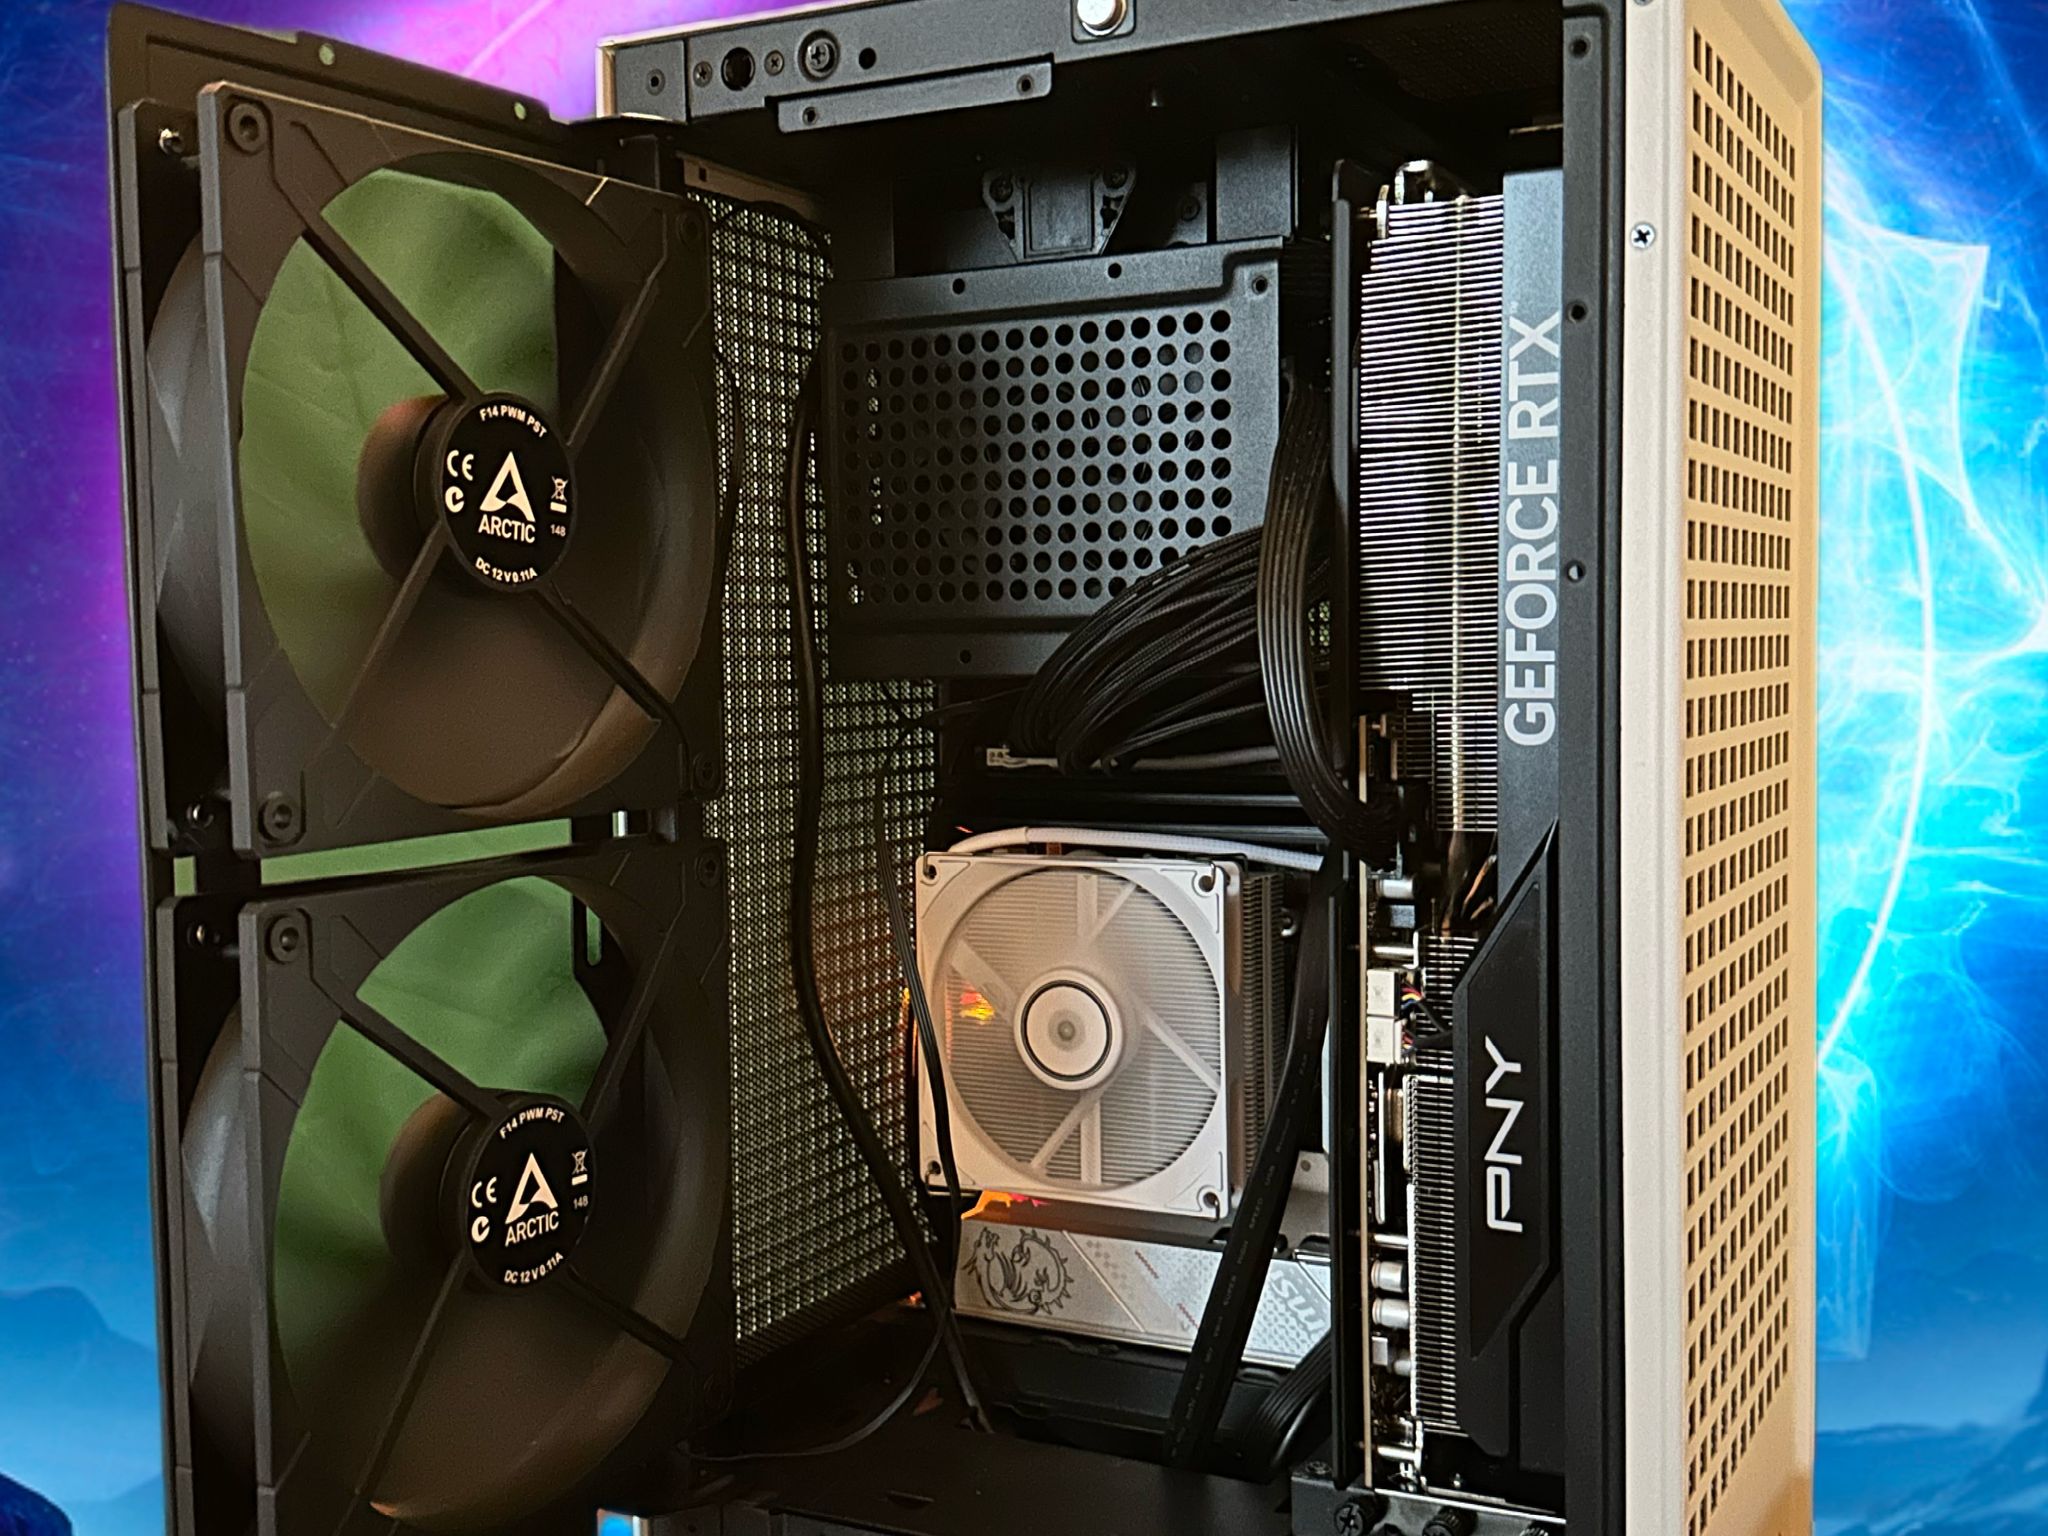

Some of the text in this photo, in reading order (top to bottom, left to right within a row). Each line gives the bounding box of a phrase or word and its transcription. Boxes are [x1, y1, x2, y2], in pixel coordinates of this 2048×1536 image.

[479, 404, 548, 437] F14 PWM PST
[477, 513, 536, 543] ARCTIC
[1504, 310, 1561, 746] GEFORCE RTX
[475, 556, 491, 575] DC
[499, 1106, 566, 1139] F14 PWM PST
[1483, 1035, 1525, 1233] PNY
[504, 1210, 560, 1247] ARCTIC
[504, 1269, 519, 1284] DC
